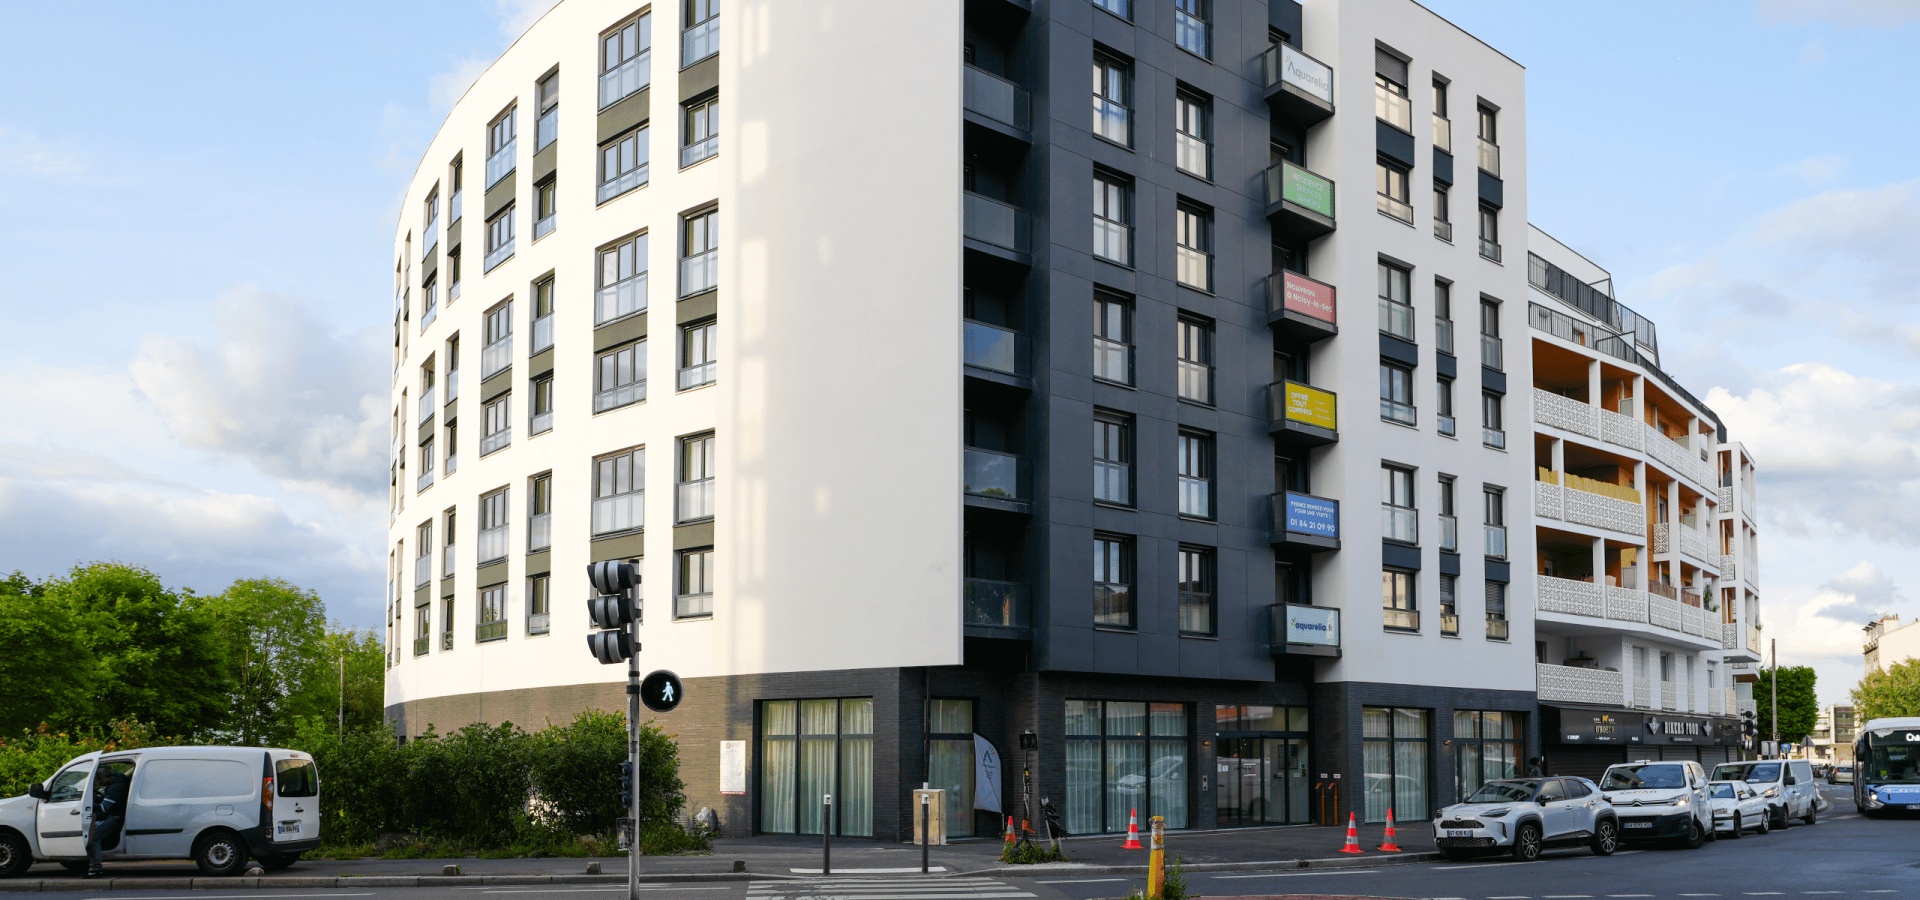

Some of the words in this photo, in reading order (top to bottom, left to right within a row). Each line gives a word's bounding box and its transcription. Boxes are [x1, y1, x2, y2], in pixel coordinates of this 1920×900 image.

[1287, 60, 1329, 91] Aquarelia
[1286, 281, 1316, 297] Nouveau
[1290, 391, 1309, 401] OFFRE
[1287, 405, 1313, 416] COMPRIS
[1292, 399, 1308, 408] TOUT
[1298, 519, 1308, 528] 84
[1316, 522, 1326, 531] 09
[1326, 524, 1336, 533] 90
[1664, 721, 1685, 735] BIKERS
[1685, 722, 1699, 735] FOOD
